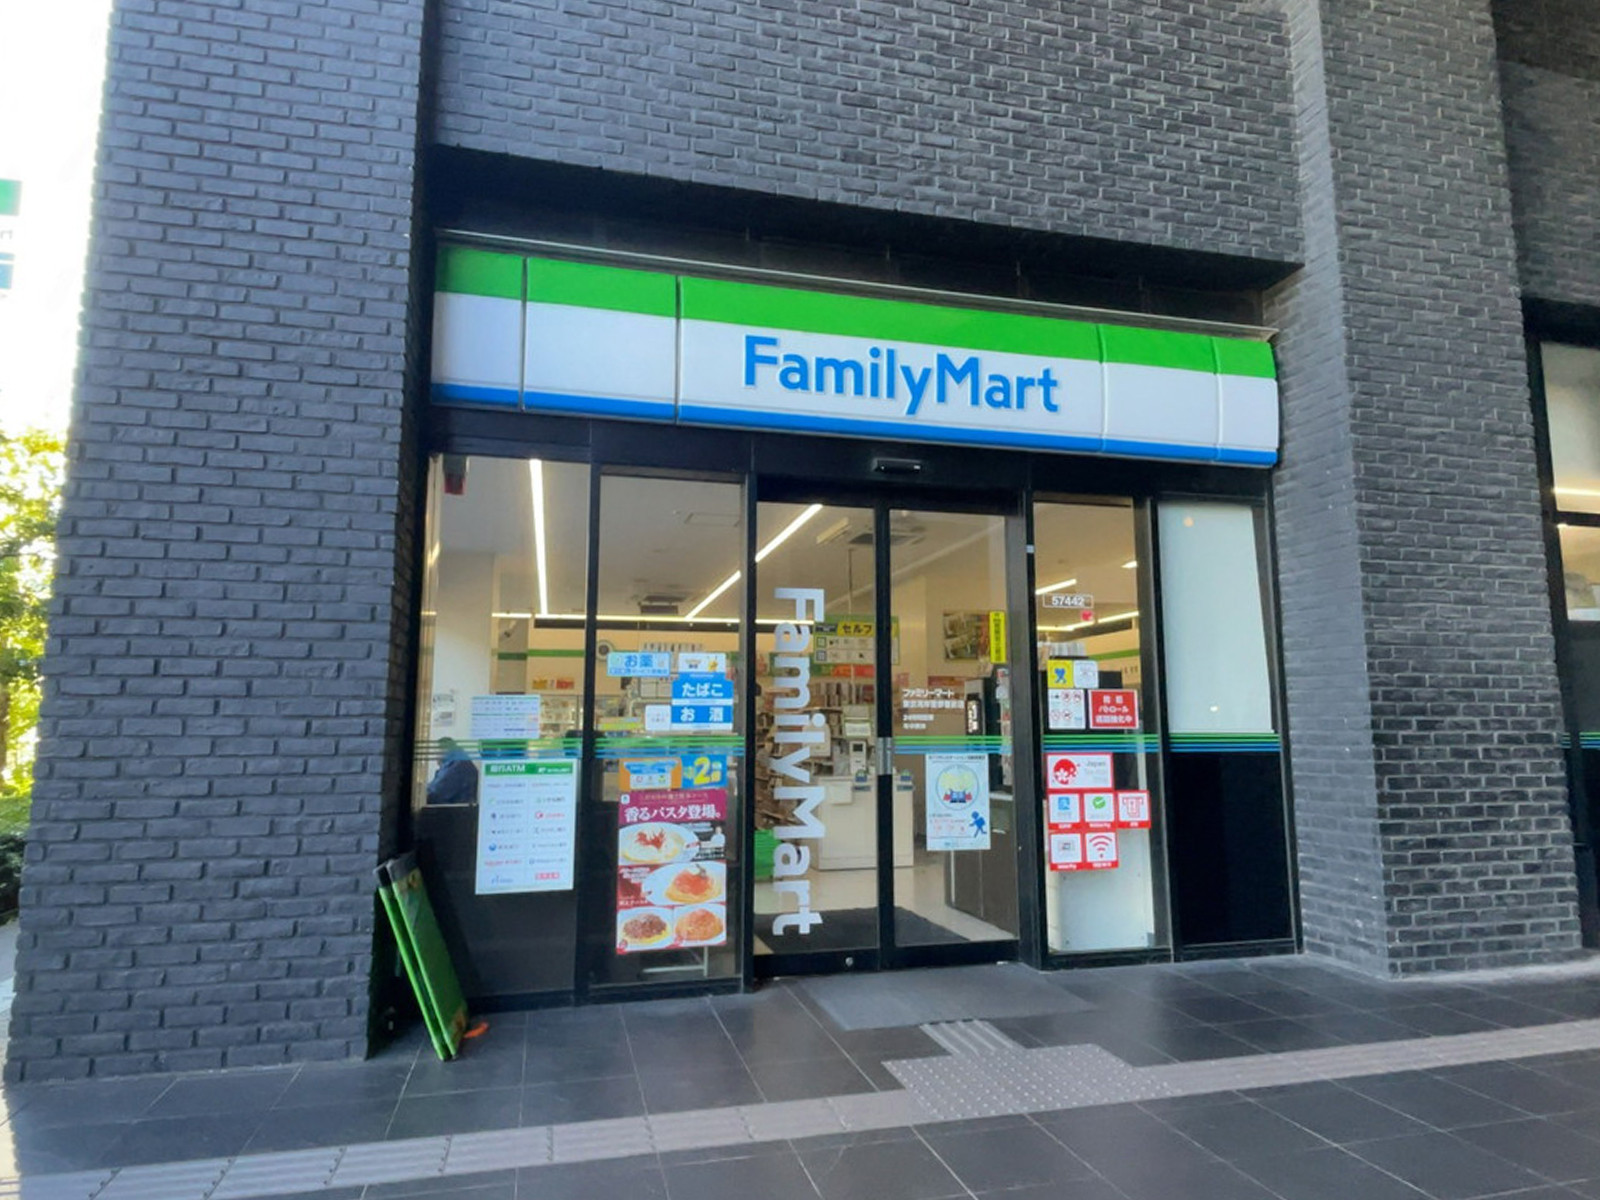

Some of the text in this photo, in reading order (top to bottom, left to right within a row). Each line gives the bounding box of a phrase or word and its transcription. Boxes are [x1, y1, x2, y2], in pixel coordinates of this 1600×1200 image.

[744, 334, 1059, 416] FamilyMart
[682, 682, 724, 697] たばこ
[902, 688, 955, 699] ファミリーマート
[680, 706, 724, 722] お酒
[768, 587, 826, 937] FamilyMart
[624, 804, 722, 823] 香るパスタ登場。
